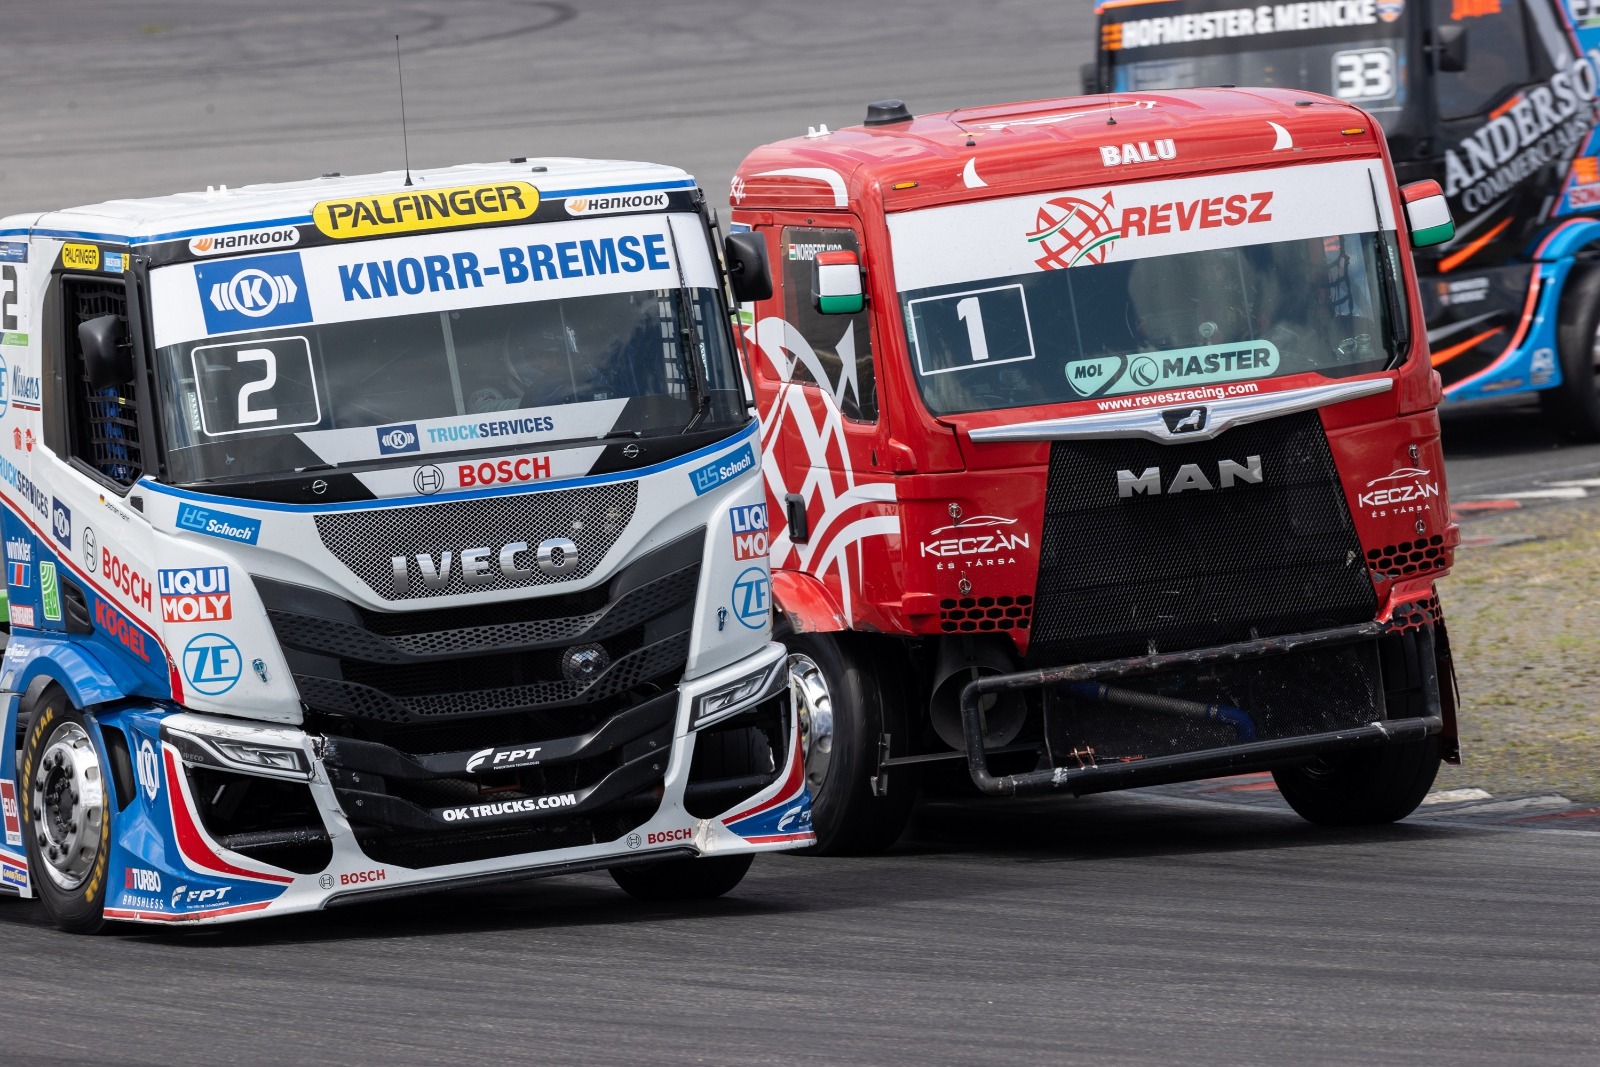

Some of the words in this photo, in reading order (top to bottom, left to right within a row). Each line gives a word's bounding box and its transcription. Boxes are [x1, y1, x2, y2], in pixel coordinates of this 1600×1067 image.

[1336, 51, 1391, 98] 33
[1446, 48, 1600, 198] ANDERSO
[1100, 137, 1177, 167] BALU
[328, 185, 527, 231] PALFINGER
[1121, 191, 1274, 239] REVESZ
[64, 247, 98, 265] PALFINGER
[338, 234, 671, 302] KNORR-BREMSE
[956, 296, 989, 361] 1
[1163, 347, 1271, 379] MASTER
[236, 348, 278, 424] 2
[1097, 382, 1259, 412] www.reveszracing.com
[427, 416, 554, 443] TRUCKSERVICES
[458, 456, 551, 487] BOSCH
[1116, 455, 1263, 498] MAN
[206, 519, 251, 540] Schoch
[102, 545, 152, 613] BOSCH
[159, 568, 227, 594] LIQUI
[391, 537, 579, 594] IVECO
[162, 594, 230, 621] MOLY
[94, 597, 150, 664] KÖGEL
[184, 644, 239, 684] ZF
[492, 747, 542, 764] FPT
[442, 806, 470, 821] OK
[470, 793, 577, 819] TRUCKS.COM
[647, 827, 693, 845] BOSCH
[340, 869, 386, 885] BOSCH
[122, 894, 164, 910] BRUSHLESS
[186, 886, 232, 903] FPT
